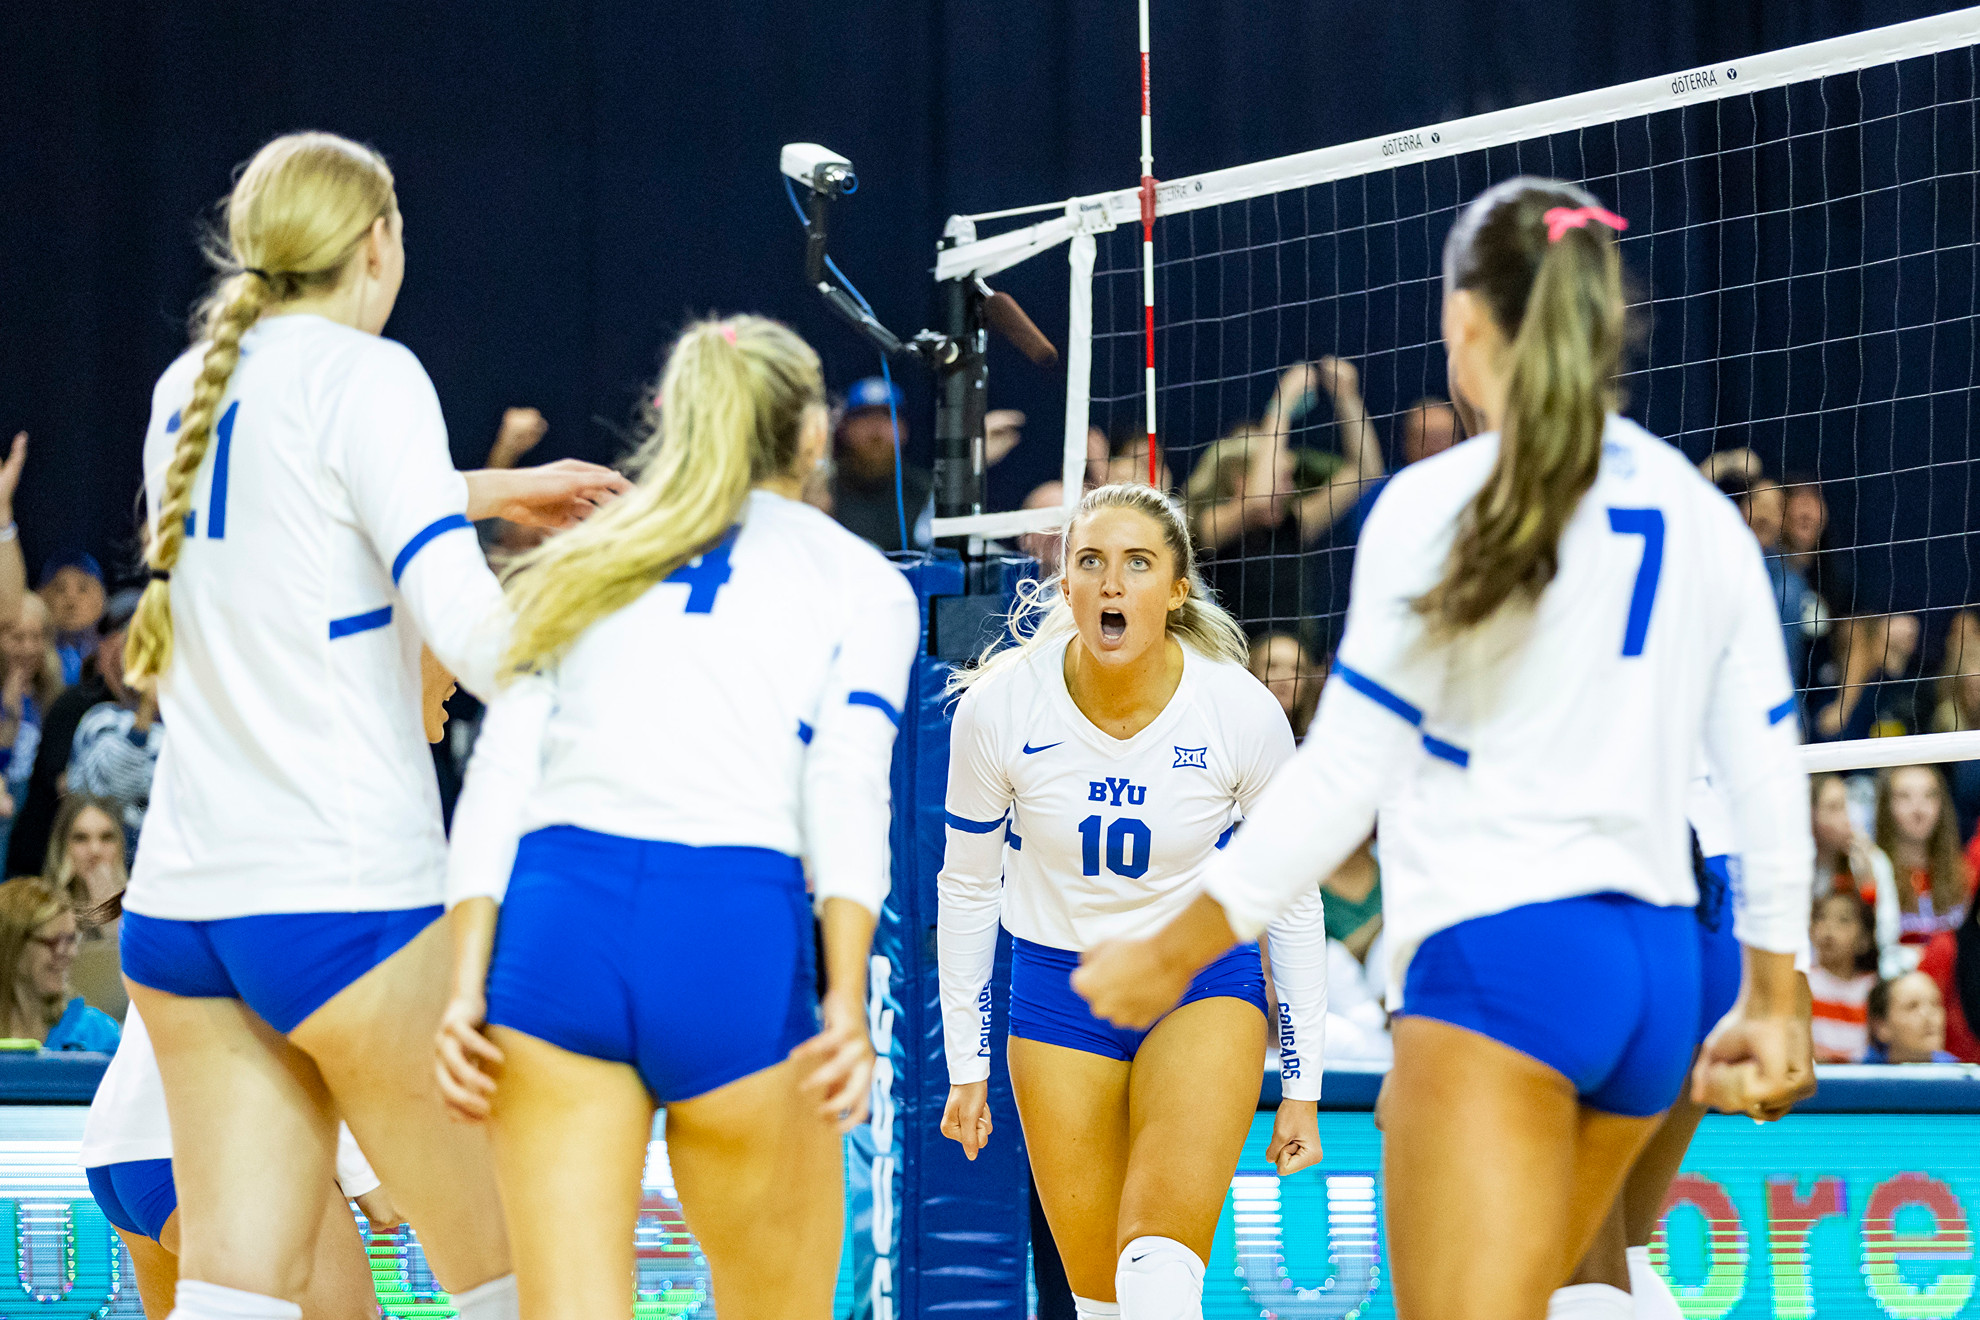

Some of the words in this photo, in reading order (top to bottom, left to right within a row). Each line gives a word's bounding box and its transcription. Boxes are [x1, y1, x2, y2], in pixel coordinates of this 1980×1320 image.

[661, 521, 743, 614] 4
[1607, 508, 1665, 656] 7
[1088, 777, 1147, 807] BYU
[1078, 815, 1151, 880] 10
[1278, 1003, 1300, 1080] COUGARS
